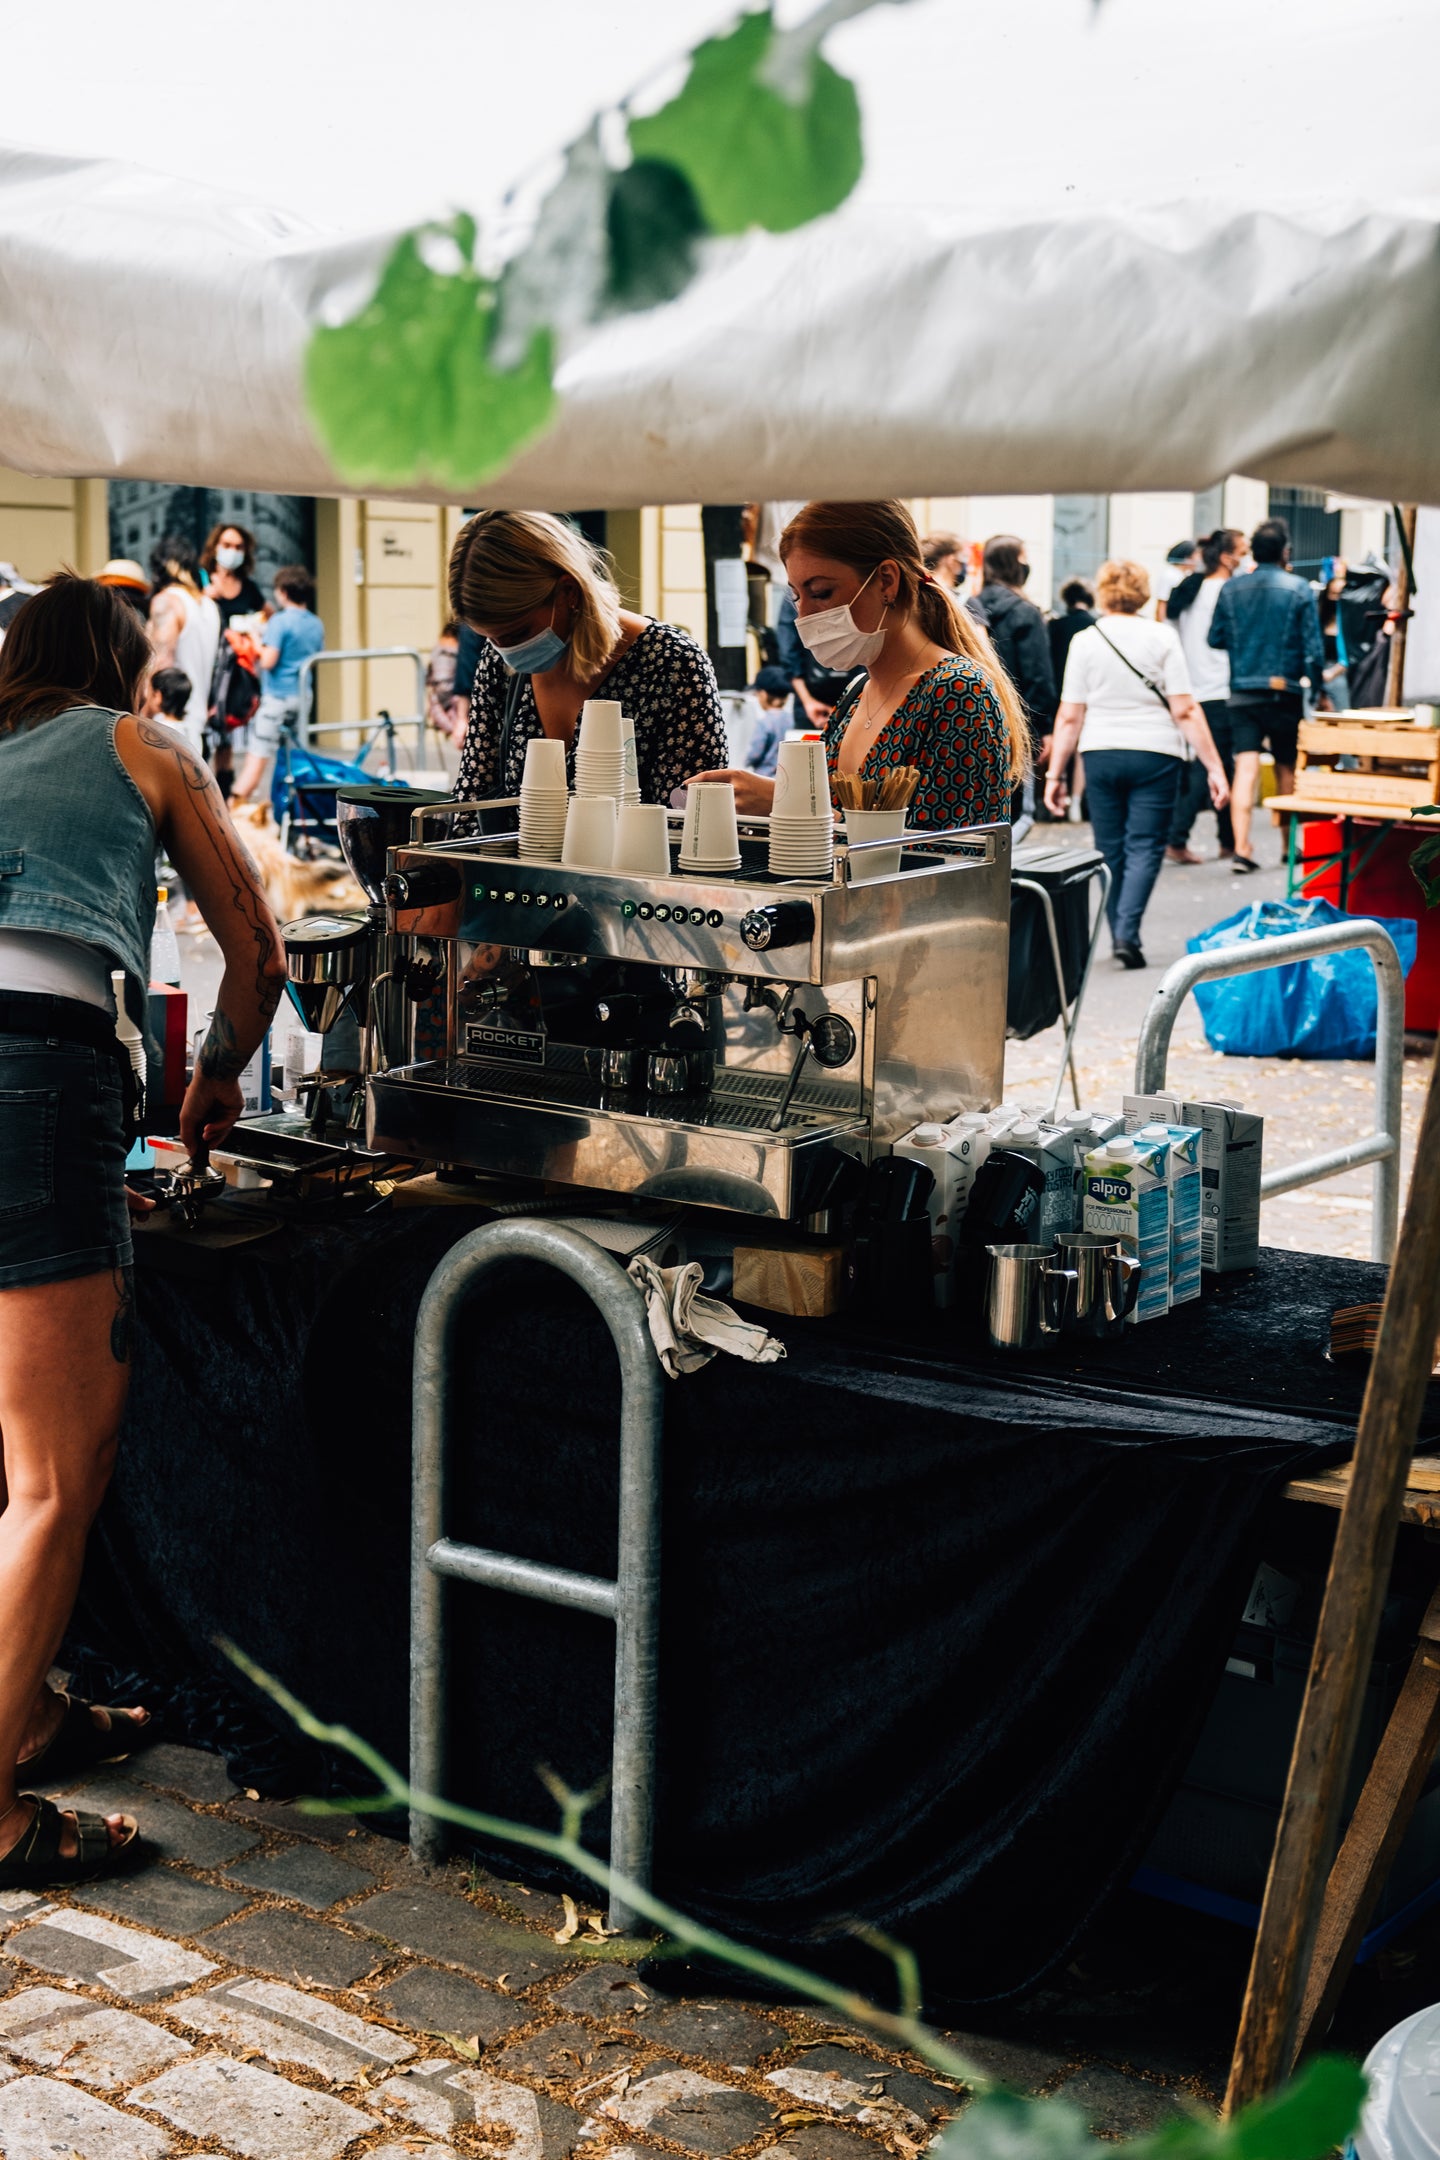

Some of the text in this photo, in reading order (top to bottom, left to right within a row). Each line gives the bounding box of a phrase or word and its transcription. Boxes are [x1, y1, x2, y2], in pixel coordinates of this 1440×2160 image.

[471, 1029, 538, 1047] ROCKET
[1091, 1179, 1128, 1198] alpro
[1095, 1204, 1132, 1215] PROFESSIONALS
[1086, 1211, 1132, 1232] COCONUT
